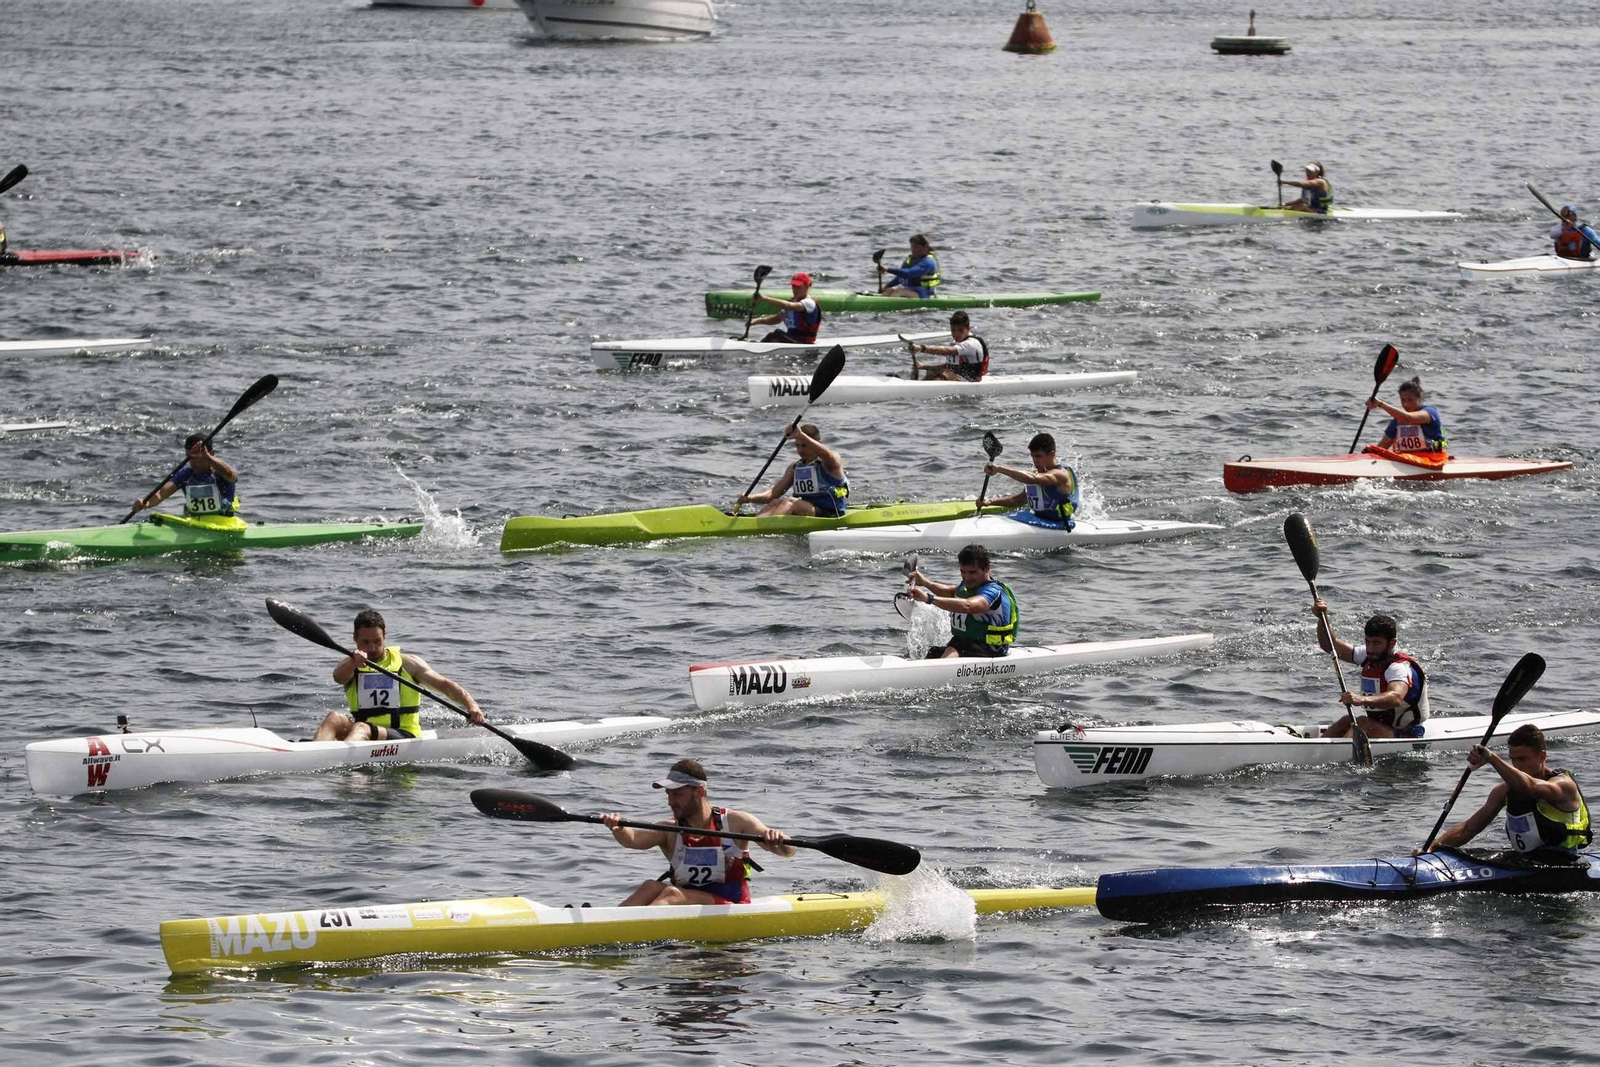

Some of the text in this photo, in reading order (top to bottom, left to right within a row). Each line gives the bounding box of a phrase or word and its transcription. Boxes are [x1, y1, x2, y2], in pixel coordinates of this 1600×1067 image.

[769, 378, 810, 396] MAZU
[1401, 437, 1422, 449] 408
[795, 480, 815, 493] 108
[191, 498, 216, 511] 318
[956, 663, 1016, 678] elio-kayaks.com
[729, 664, 787, 696] MAZU
[369, 690, 390, 706] 12
[82, 754, 121, 765] Allwave.it
[370, 745, 399, 758] surfski
[1091, 747, 1154, 774] FENN
[1515, 833, 1526, 850] 6
[688, 867, 712, 885] 22
[206, 911, 317, 958] MAZU
